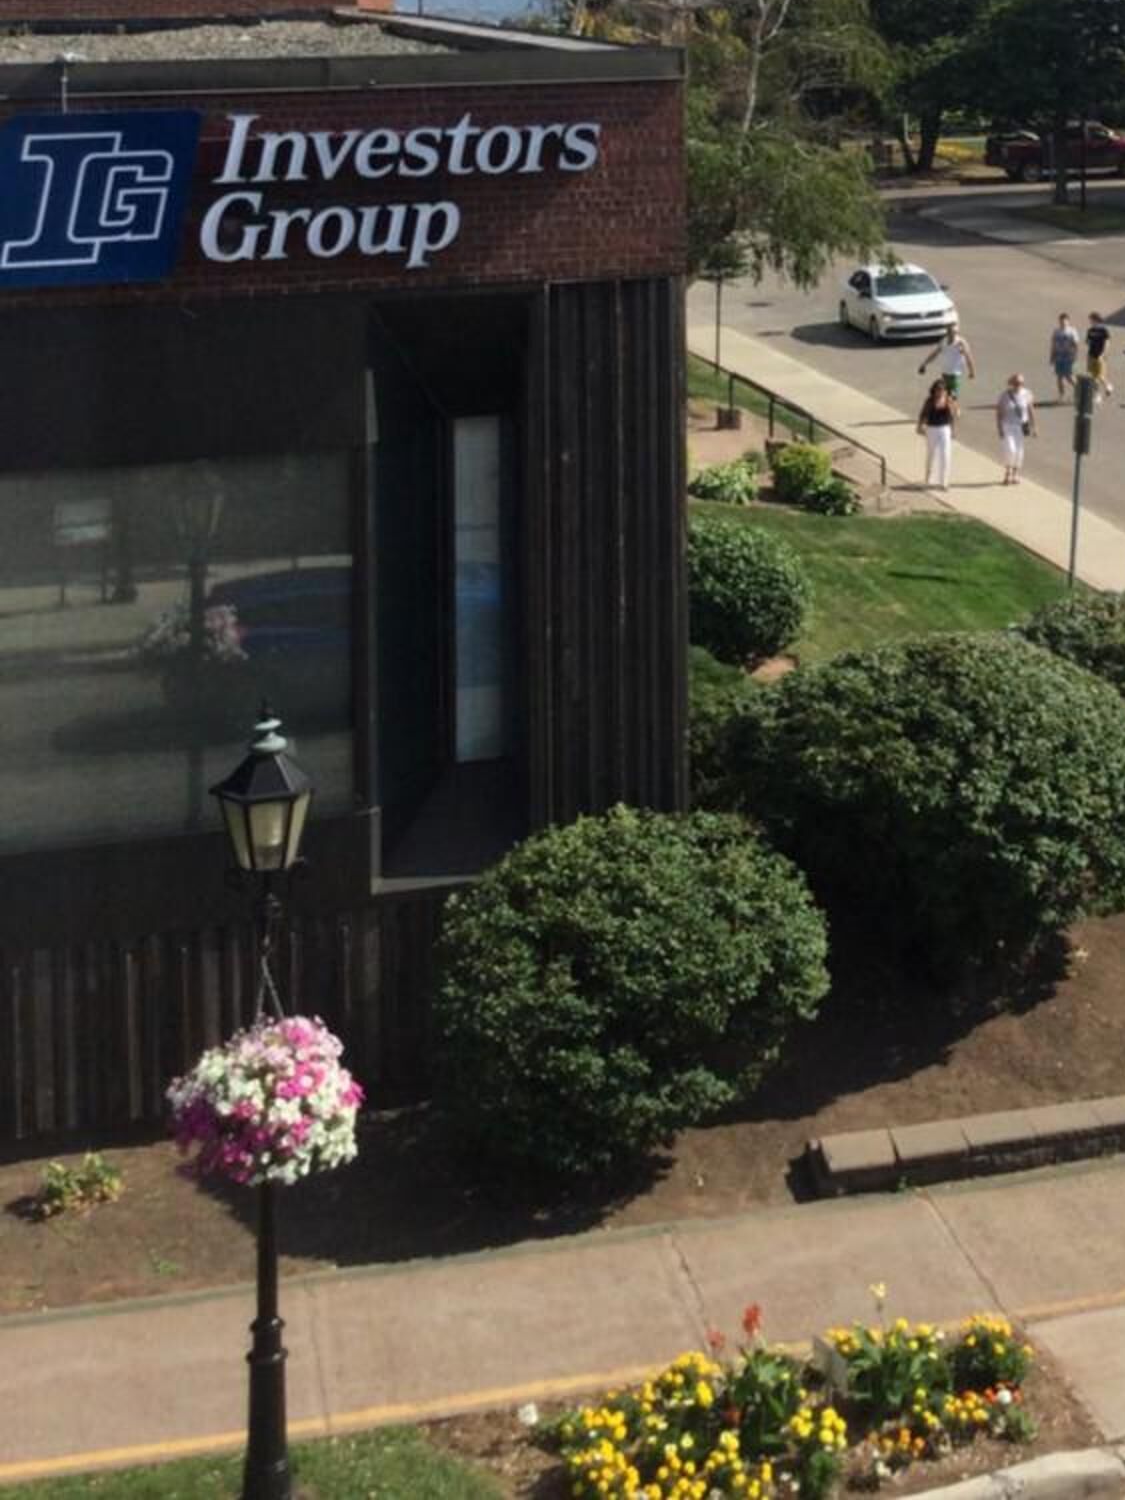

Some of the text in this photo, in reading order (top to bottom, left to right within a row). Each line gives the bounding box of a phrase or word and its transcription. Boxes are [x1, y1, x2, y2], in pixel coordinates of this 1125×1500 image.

[211, 112, 601, 185] Investors
[0, 131, 175, 269] IG
[200, 190, 460, 269] Group
